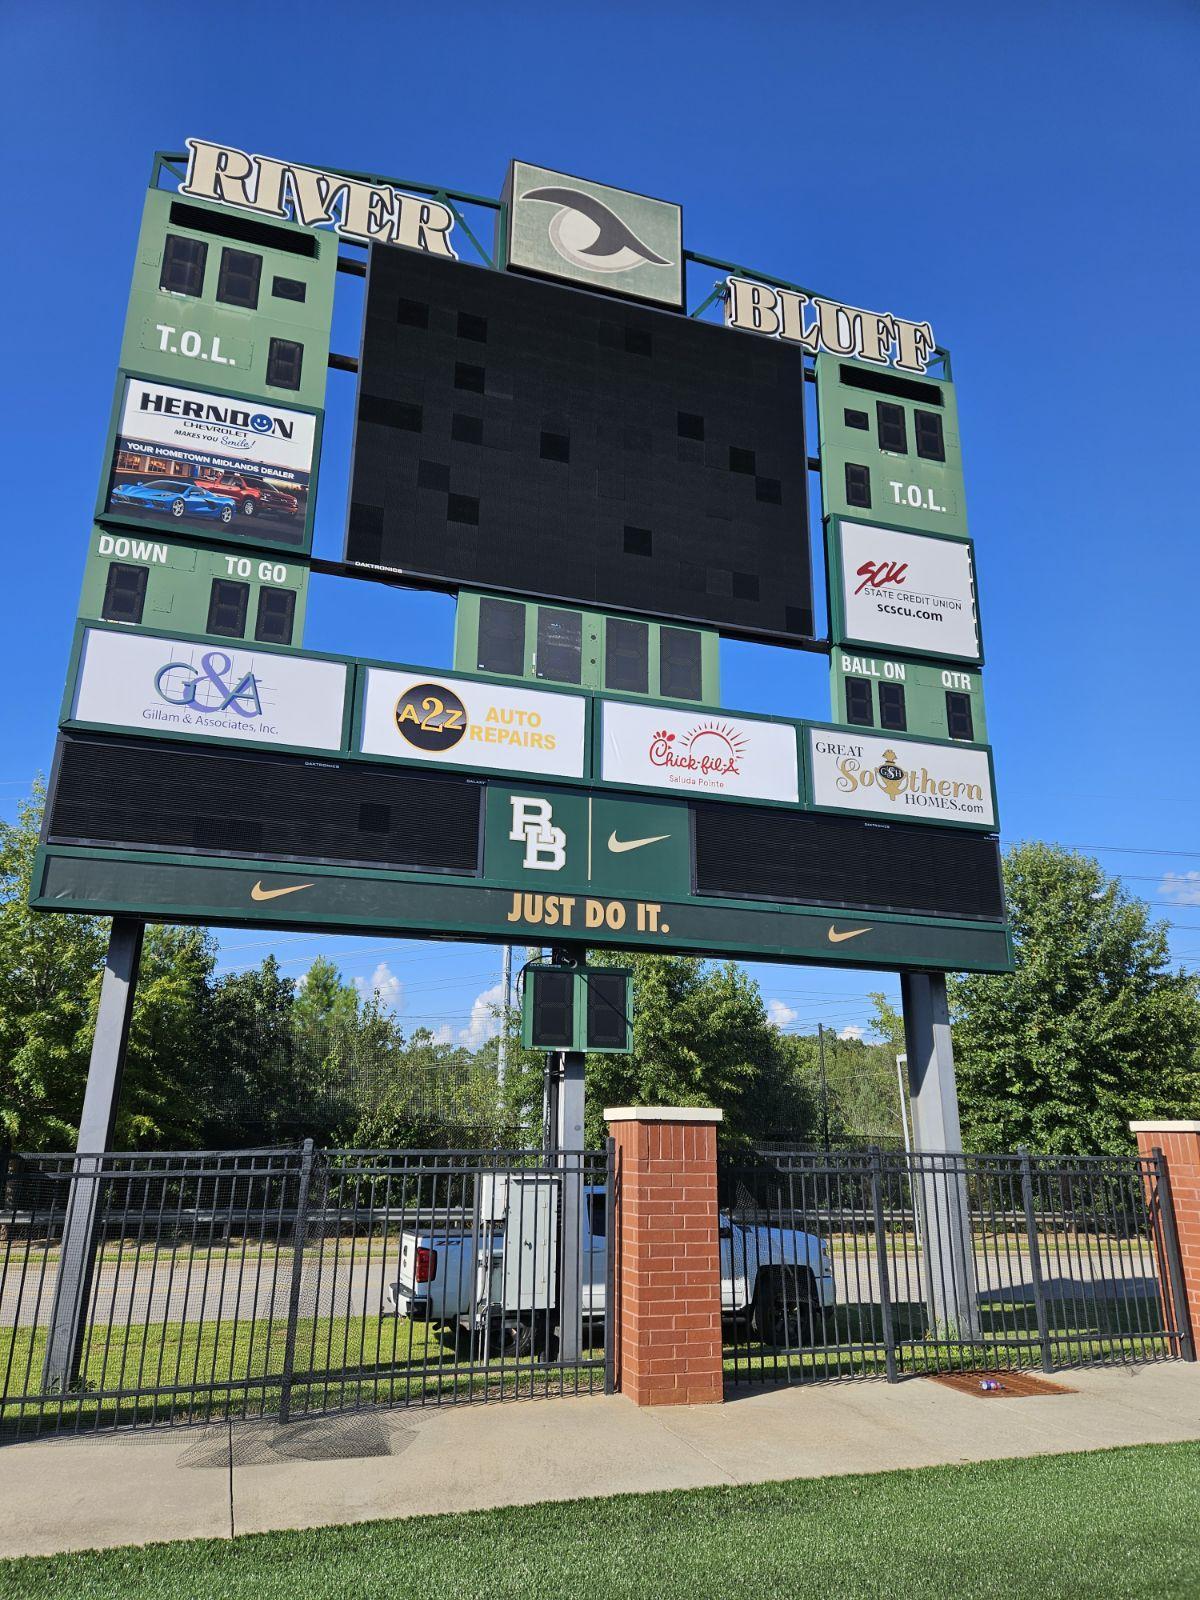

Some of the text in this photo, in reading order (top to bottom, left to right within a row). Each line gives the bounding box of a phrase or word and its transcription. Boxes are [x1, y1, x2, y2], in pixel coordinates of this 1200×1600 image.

[179, 138, 458, 260] RIVER
[727, 276, 936, 374] BLUFF
[156, 324, 236, 366] T.O.L.
[140, 392, 294, 439] HERNDON
[174, 429, 256, 449] MAKES YOU Smile!
[183, 421, 248, 438] CHEVROLET
[127, 442, 295, 480] YOUR HOMETOWN MIDLANDS DEALER
[890, 481, 947, 512] T.O.L.
[98, 535, 168, 564] DOWN
[224, 556, 287, 583] TO GO
[354, 561, 403, 574] DAKTRONICS
[864, 587, 962, 611] STATE CREDIT UNION
[877, 603, 943, 622] scscu.com
[842, 655, 905, 681] BALL ON
[941, 670, 971, 690] QTR
[154, 651, 262, 718] G&A
[142, 708, 279, 735] Gillam & Associates, Inc.
[398, 697, 463, 733] A2Z
[485, 706, 542, 729] AUTO
[469, 724, 556, 751] REPAIRS
[815, 741, 864, 757] GREAT
[650, 731, 740, 776] Chick-fil-A
[669, 774, 724, 788] Saluda Pointe
[905, 793, 984, 813] HOMES.com
[507, 892, 670, 934] JUST DO IT.
